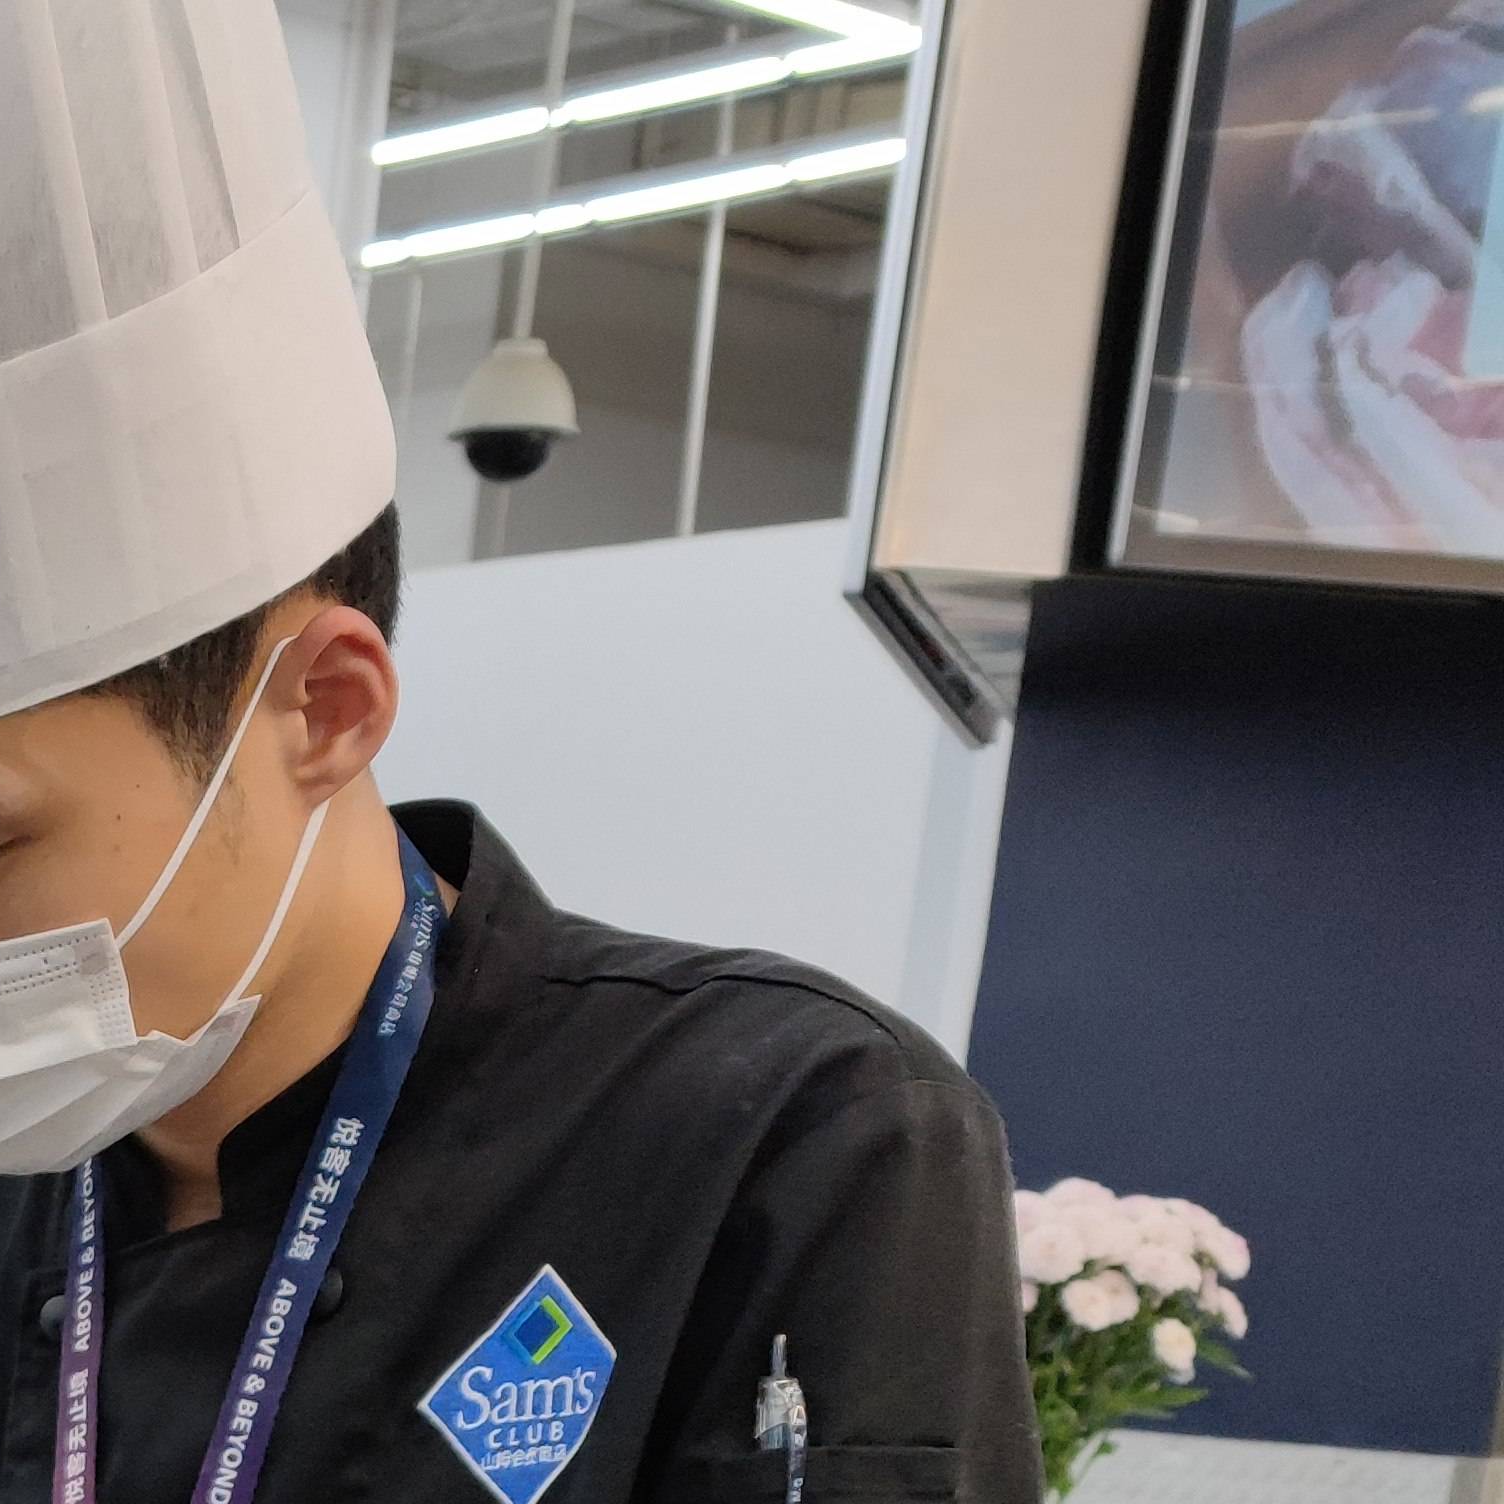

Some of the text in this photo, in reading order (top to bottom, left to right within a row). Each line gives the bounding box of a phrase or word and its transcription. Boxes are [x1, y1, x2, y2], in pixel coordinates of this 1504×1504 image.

[80, 1158, 95, 1243] BEYON
[289, 1117, 364, 1261] 悦客无止境
[80, 1246, 94, 1264] &
[74, 1271, 94, 1352] ABOVE
[248, 1277, 298, 1372] ABOVE
[243, 1373, 266, 1394] &
[457, 1365, 597, 1430] Sam's
[485, 1420, 565, 1449] CLUB
